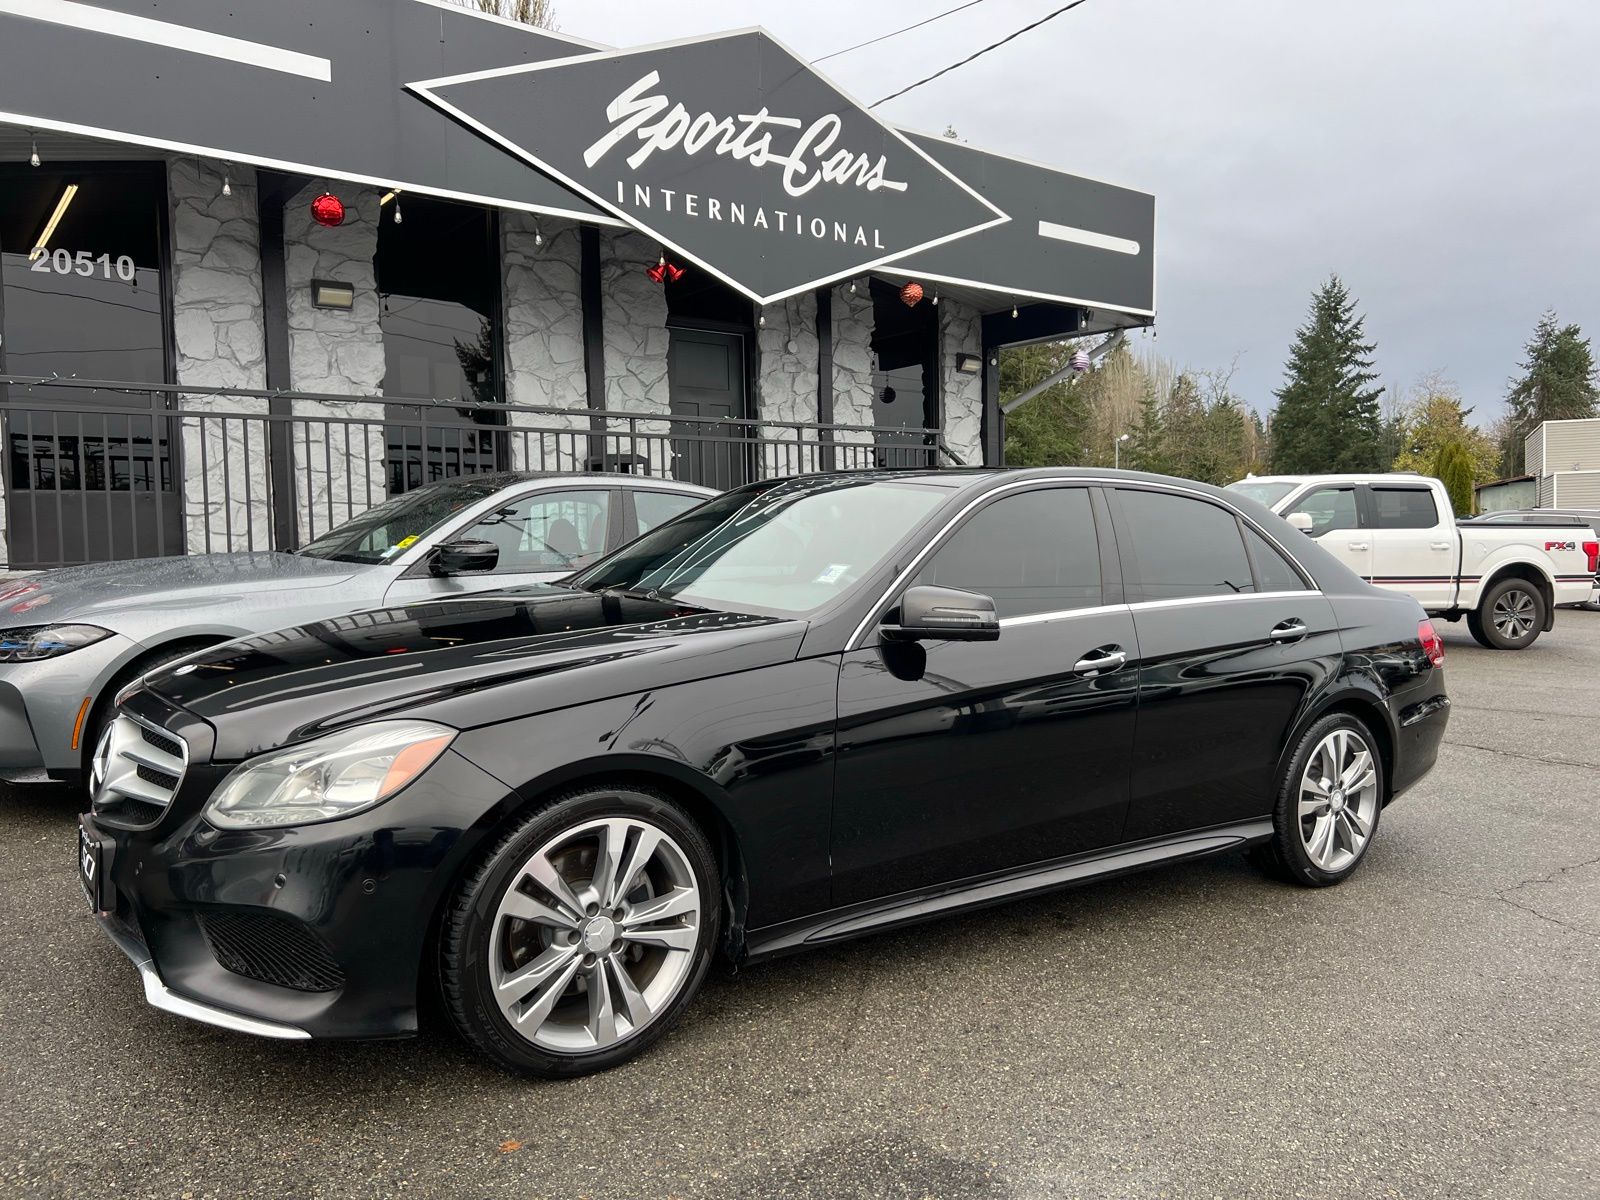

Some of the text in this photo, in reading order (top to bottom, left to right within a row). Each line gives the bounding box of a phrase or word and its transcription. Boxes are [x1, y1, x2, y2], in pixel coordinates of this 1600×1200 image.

[583, 70, 908, 197] Sports Cars
[617, 180, 885, 249] INTERNATIONAL
[30, 246, 135, 281] 20510
[1545, 541, 1576, 551] FX4
